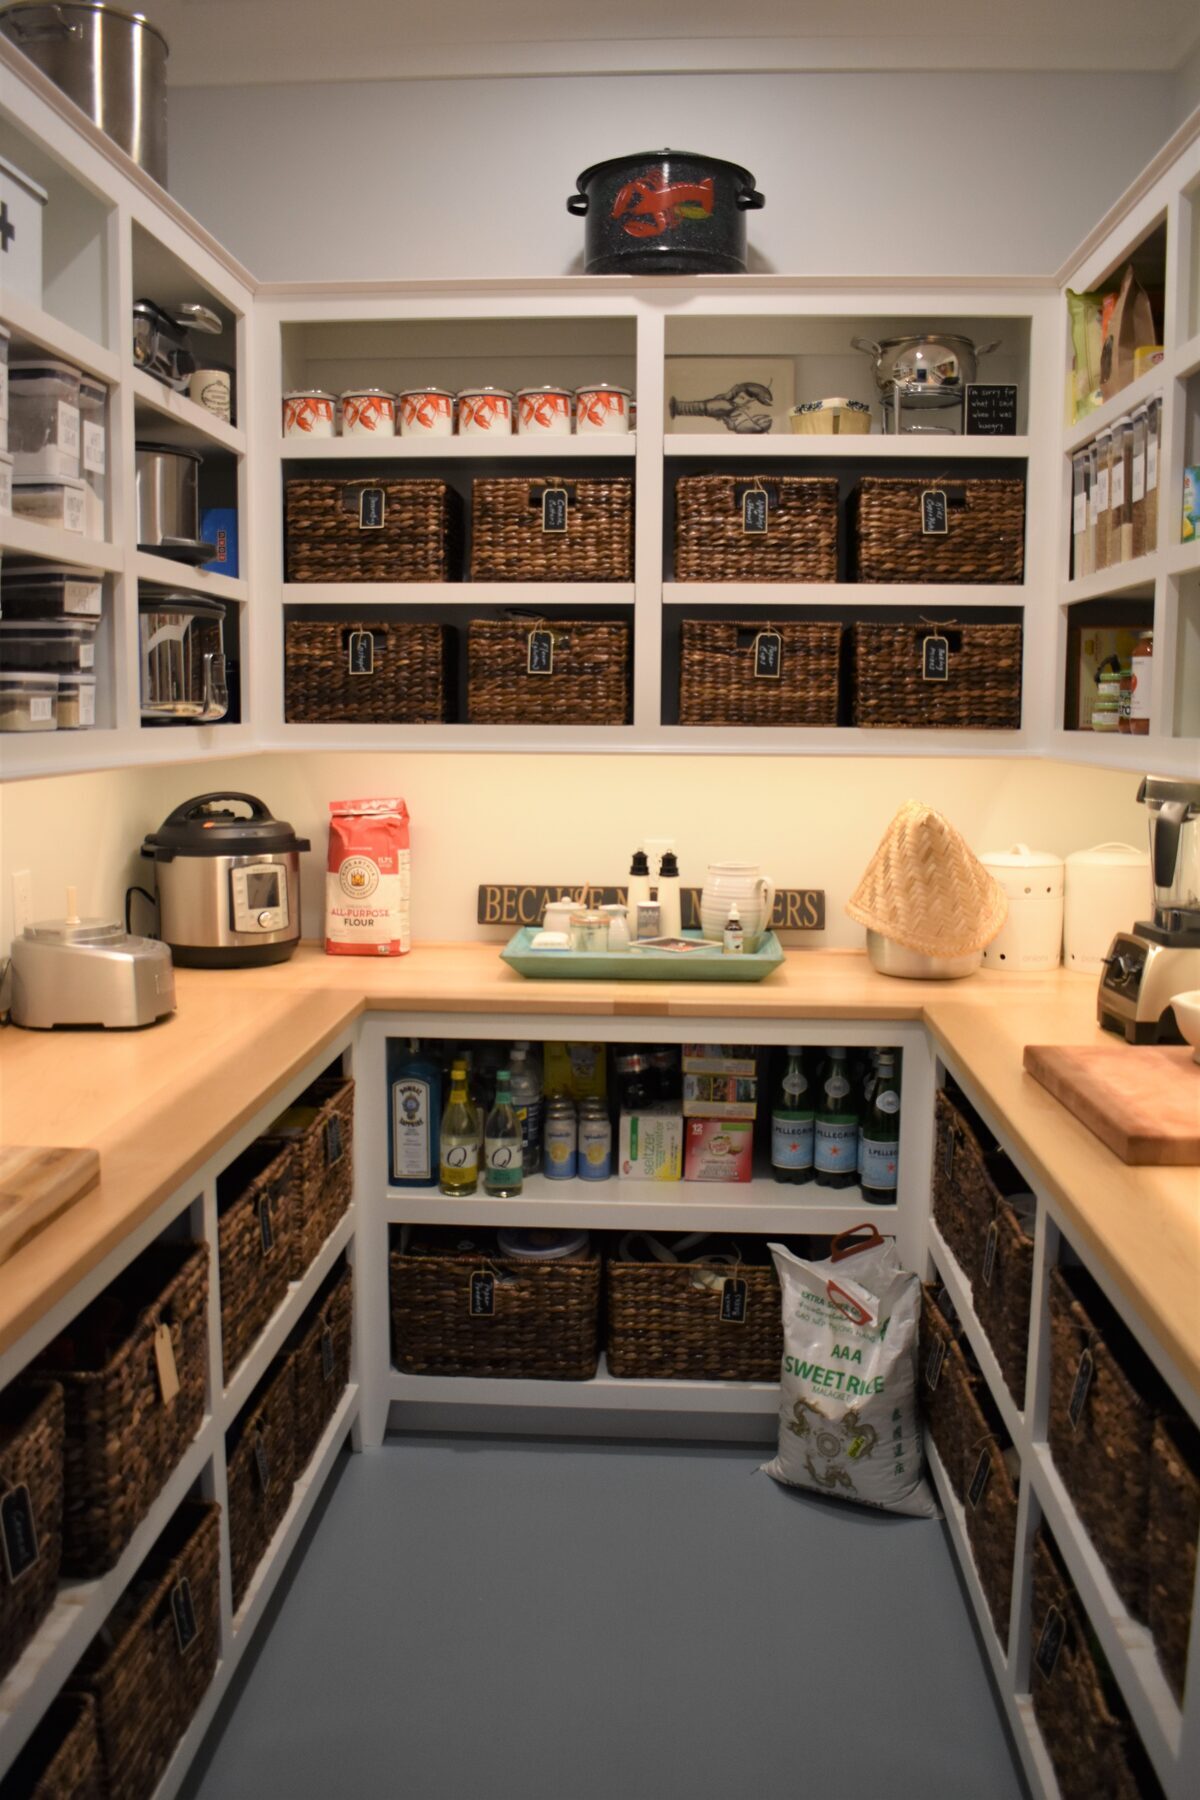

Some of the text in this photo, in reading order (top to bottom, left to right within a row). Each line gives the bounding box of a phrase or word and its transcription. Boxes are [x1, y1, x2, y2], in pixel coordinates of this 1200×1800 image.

[982, 389, 1000, 398] sorry
[1004, 387, 1015, 397] for
[971, 398, 988, 408] what
[999, 398, 1013, 407] said
[972, 410, 989, 418] when
[331, 908, 390, 918] ALL-PURPOSE
[344, 918, 374, 927] FLOUR
[692, 1123, 703, 1132] 12
[447, 1146, 467, 1168] Q
[492, 1146, 512, 1168] Q
[641, 1131, 655, 1175] seltzer
[831, 1344, 862, 1364] AAA
[784, 1355, 885, 1397] SWEET RICE
